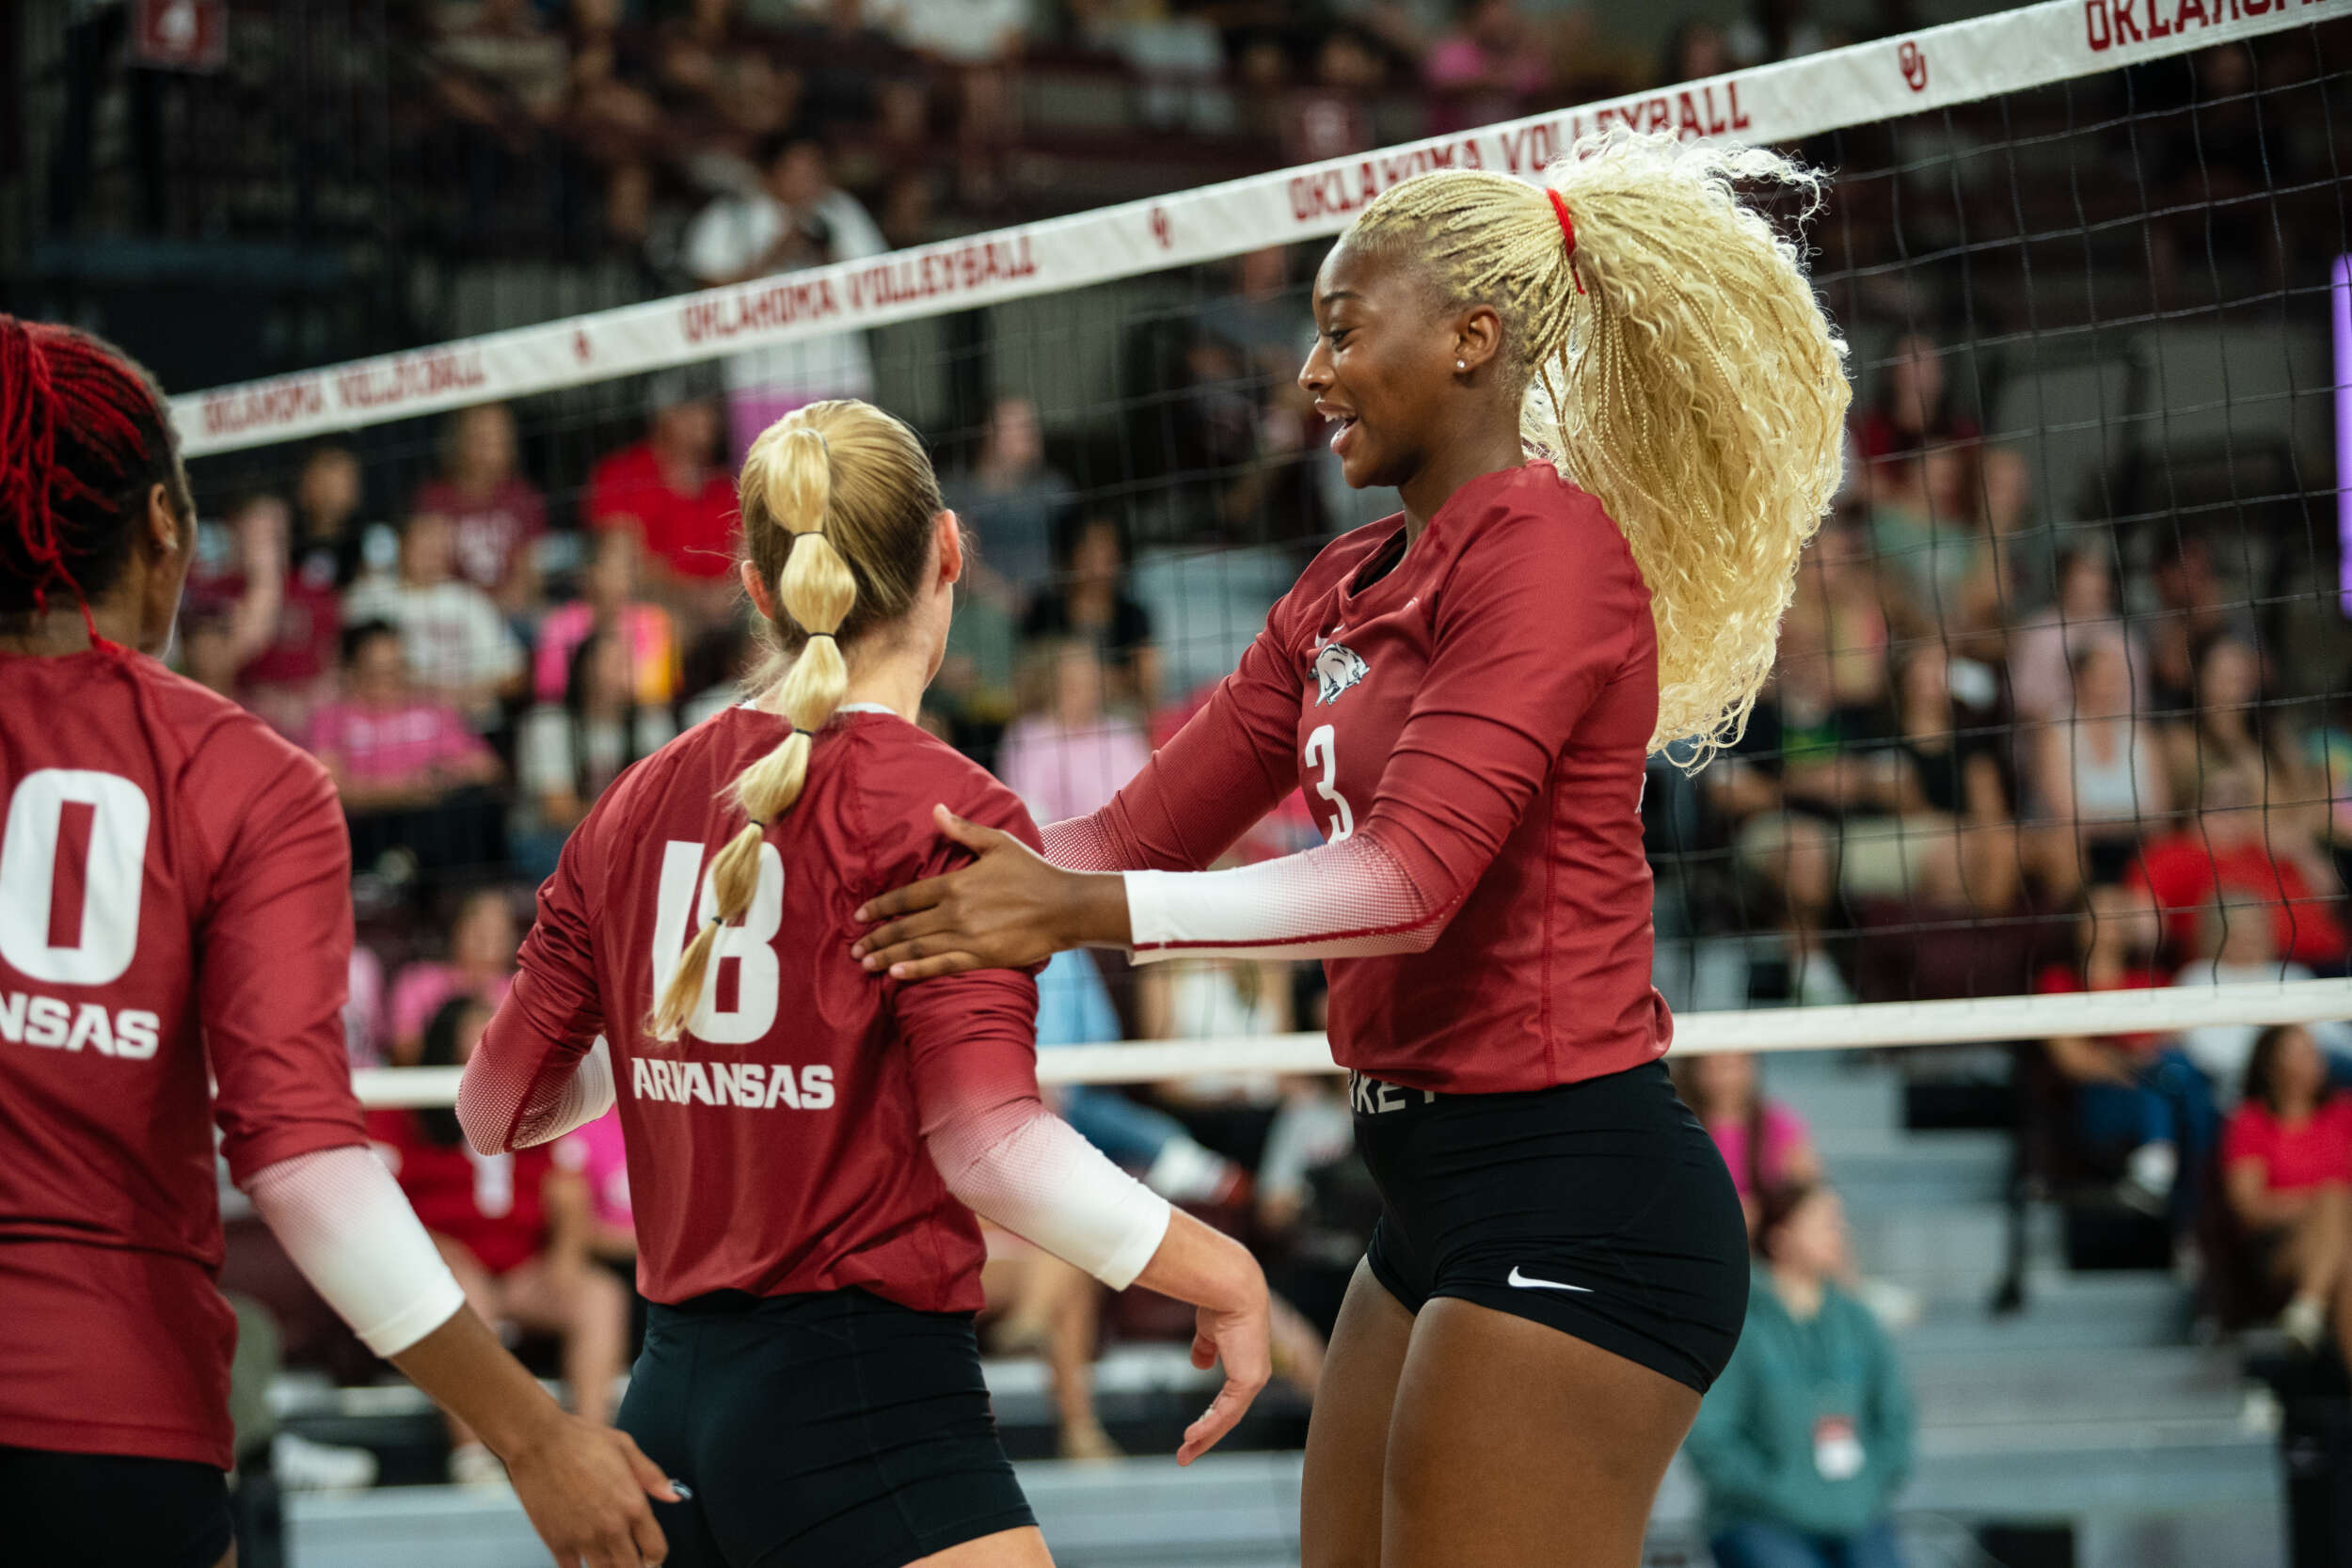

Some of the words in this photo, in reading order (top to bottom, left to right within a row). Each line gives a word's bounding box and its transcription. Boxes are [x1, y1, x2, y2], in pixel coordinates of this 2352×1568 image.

[682, 279, 840, 343] OKLAHOMA
[847, 235, 1038, 309] VOLLEYBALL
[1304, 723, 1354, 844] 3
[0, 768, 151, 986] 0
[652, 840, 785, 1044] 18
